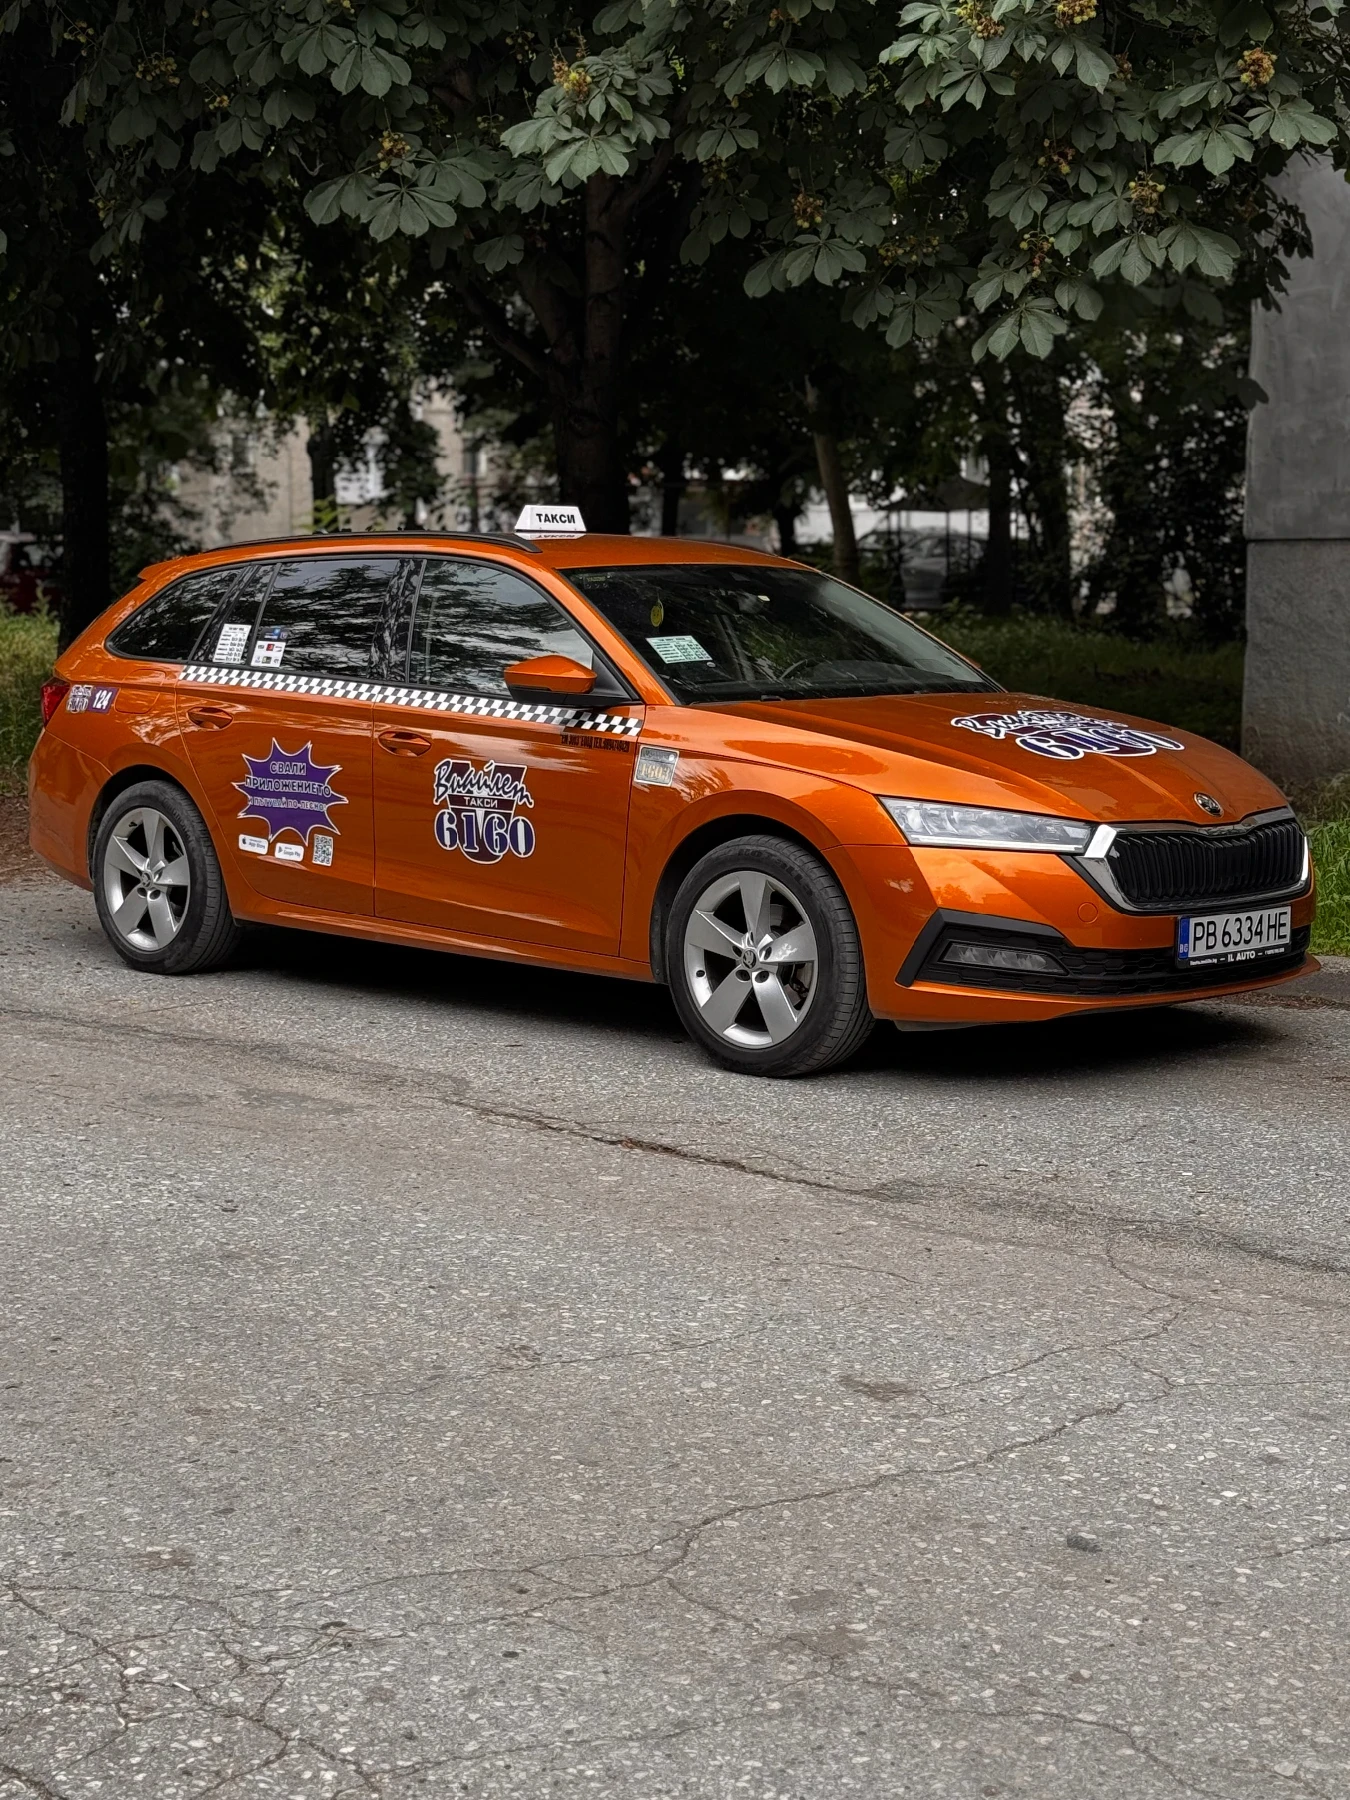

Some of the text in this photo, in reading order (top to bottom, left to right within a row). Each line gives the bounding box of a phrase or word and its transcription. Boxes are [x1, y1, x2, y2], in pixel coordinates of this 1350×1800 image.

[536, 513, 576, 524] ТАКСИ
[93, 689, 113, 710] 124
[270, 761, 307, 776] СВАЛИ
[244, 775, 332, 798] ПРИЛОЖЕНИЕТО
[463, 796, 499, 809] ТАКСИ
[434, 809, 536, 858] 6160
[1193, 911, 1288, 953] PB 6334 HE
[1179, 943, 1189, 954] BG
[1235, 950, 1256, 961] AUTO
